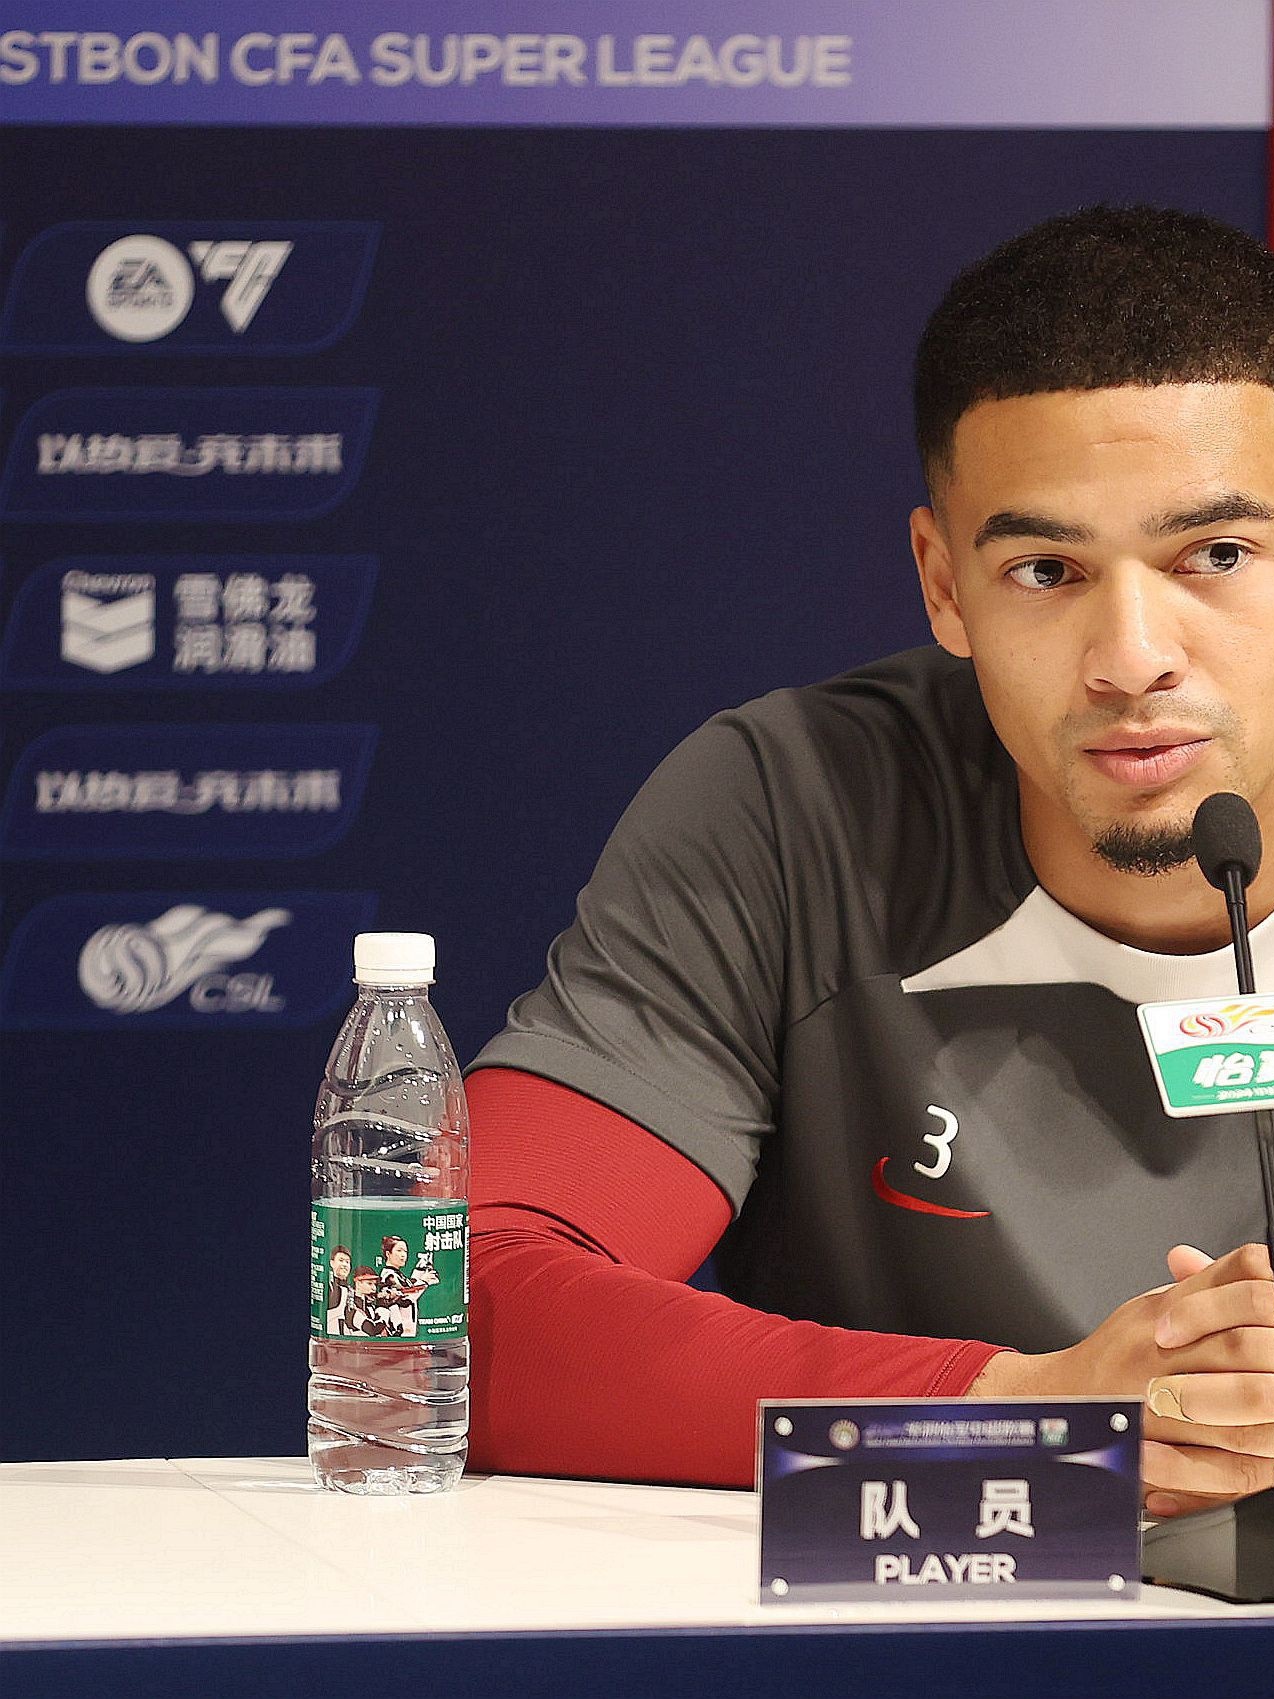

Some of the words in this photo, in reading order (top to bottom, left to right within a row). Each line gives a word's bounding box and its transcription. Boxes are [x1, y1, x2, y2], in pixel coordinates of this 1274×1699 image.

[0, 30, 220, 85] STBON
[230, 32, 360, 86] CFA
[370, 33, 587, 87] SUPER
[598, 34, 852, 87] LEAGUE
[173, 572, 317, 624] 雪佛龙
[190, 973, 286, 1013] CSL
[913, 1104, 959, 1179] 3
[423, 1213, 464, 1231] 中国国家
[424, 1229, 464, 1252] 射击队
[859, 1479, 1036, 1541] 队员
[875, 1552, 1018, 1585] PLAYER
